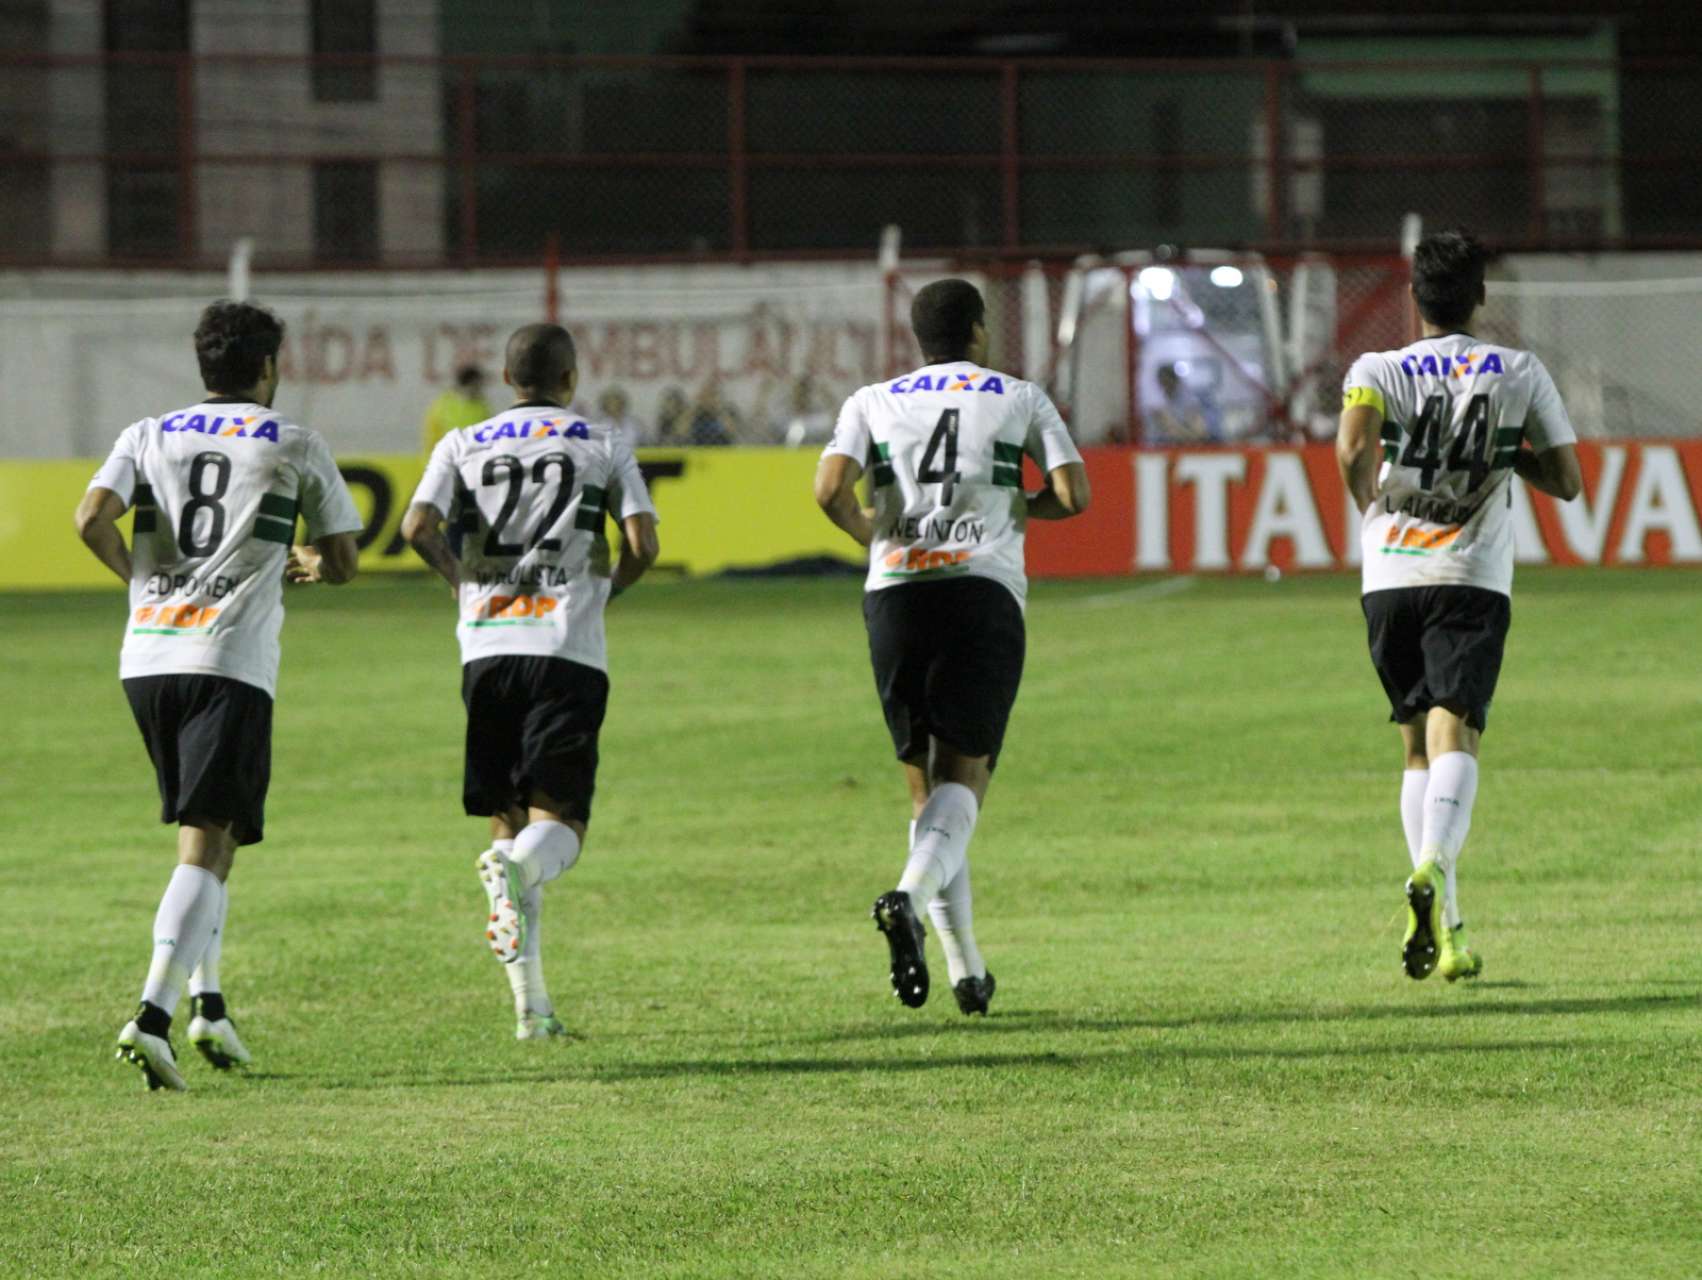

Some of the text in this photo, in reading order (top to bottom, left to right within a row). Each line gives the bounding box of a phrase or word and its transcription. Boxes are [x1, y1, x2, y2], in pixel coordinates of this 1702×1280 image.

[889, 374, 1005, 395] CAIXA
[1401, 353, 1504, 378] CAIXA
[161, 413, 280, 443] CAIXA
[473, 419, 590, 444] CAIXA
[918, 407, 962, 507] 4
[1400, 394, 1490, 494] 44
[178, 450, 231, 558] 8
[481, 452, 576, 557] 22
